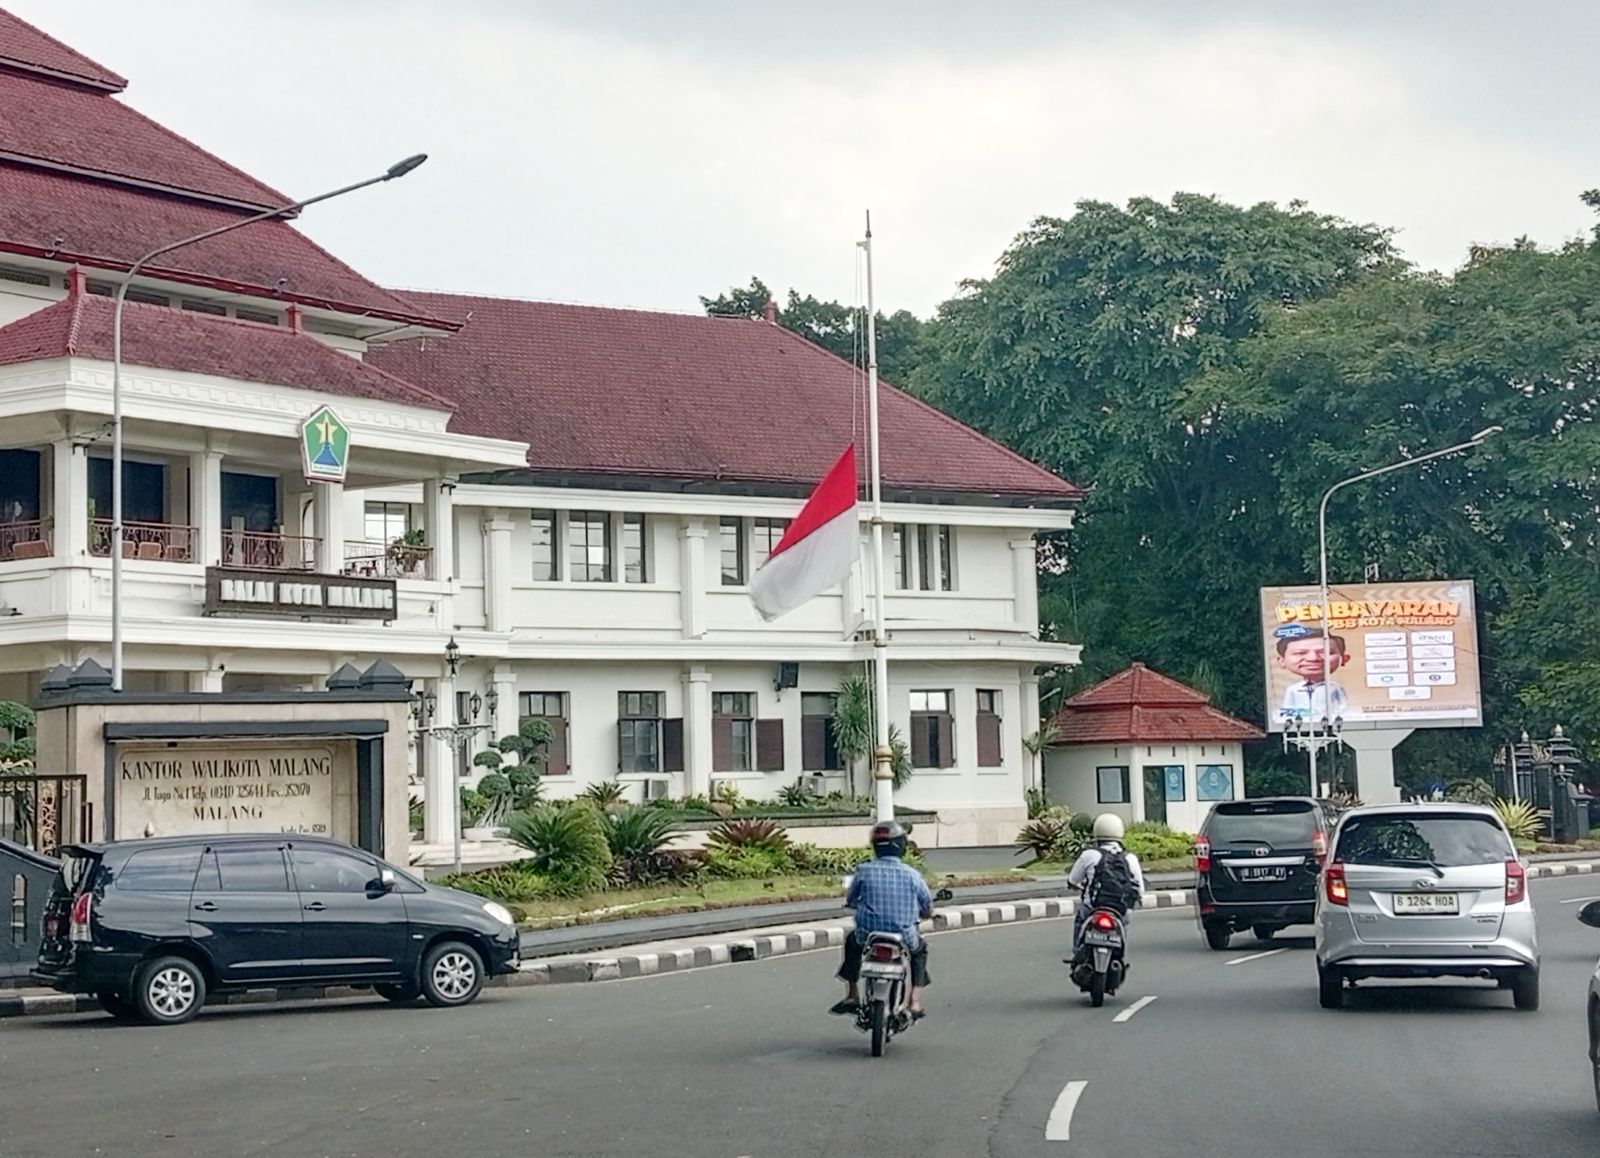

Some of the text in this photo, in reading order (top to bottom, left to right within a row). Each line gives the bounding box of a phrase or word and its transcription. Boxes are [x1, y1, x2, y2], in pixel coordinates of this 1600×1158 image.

[220, 579, 394, 609] BALAI KOTA MALANG
[1276, 599, 1460, 622] PEMBAYARAN
[1358, 617, 1395, 627] KOTA
[122, 757, 331, 780] KANTOR WALIKOTA MALANG
[193, 805, 263, 820] MALANG
